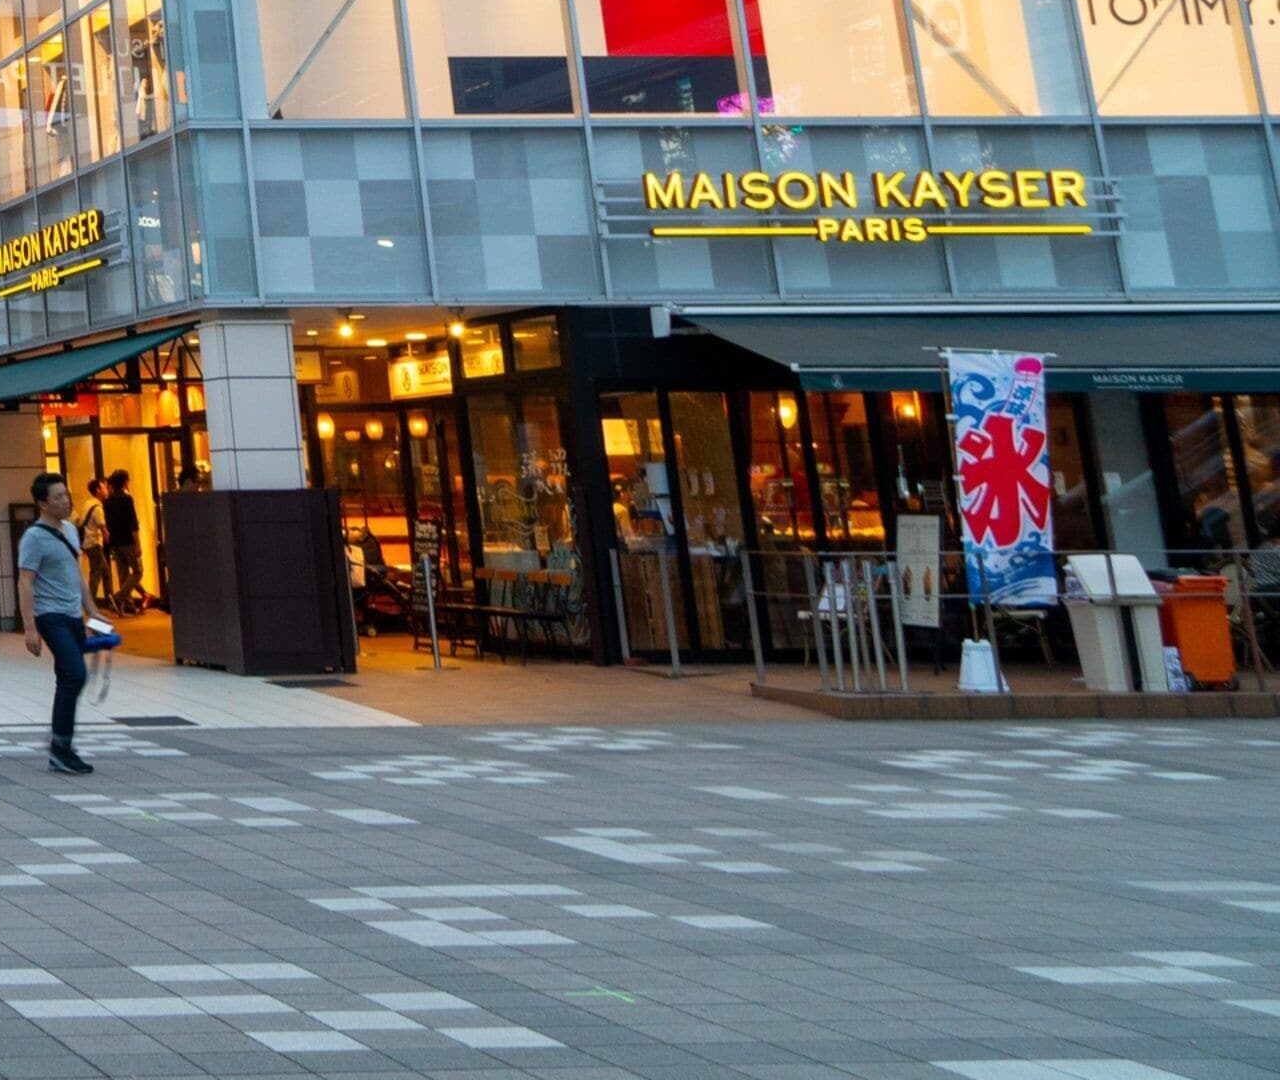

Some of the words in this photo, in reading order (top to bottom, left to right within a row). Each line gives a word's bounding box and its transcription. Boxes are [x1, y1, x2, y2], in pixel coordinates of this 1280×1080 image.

[643, 170, 858, 211] MAISON
[871, 169, 1088, 210] KAYSER
[42, 208, 102, 259] KAYSER
[815, 217, 928, 243] PARIS
[31, 267, 59, 292] PARIS
[1092, 374, 1137, 384] MAISON
[1139, 374, 1184, 384] KAYSER
[956, 413, 1052, 549] 氷
